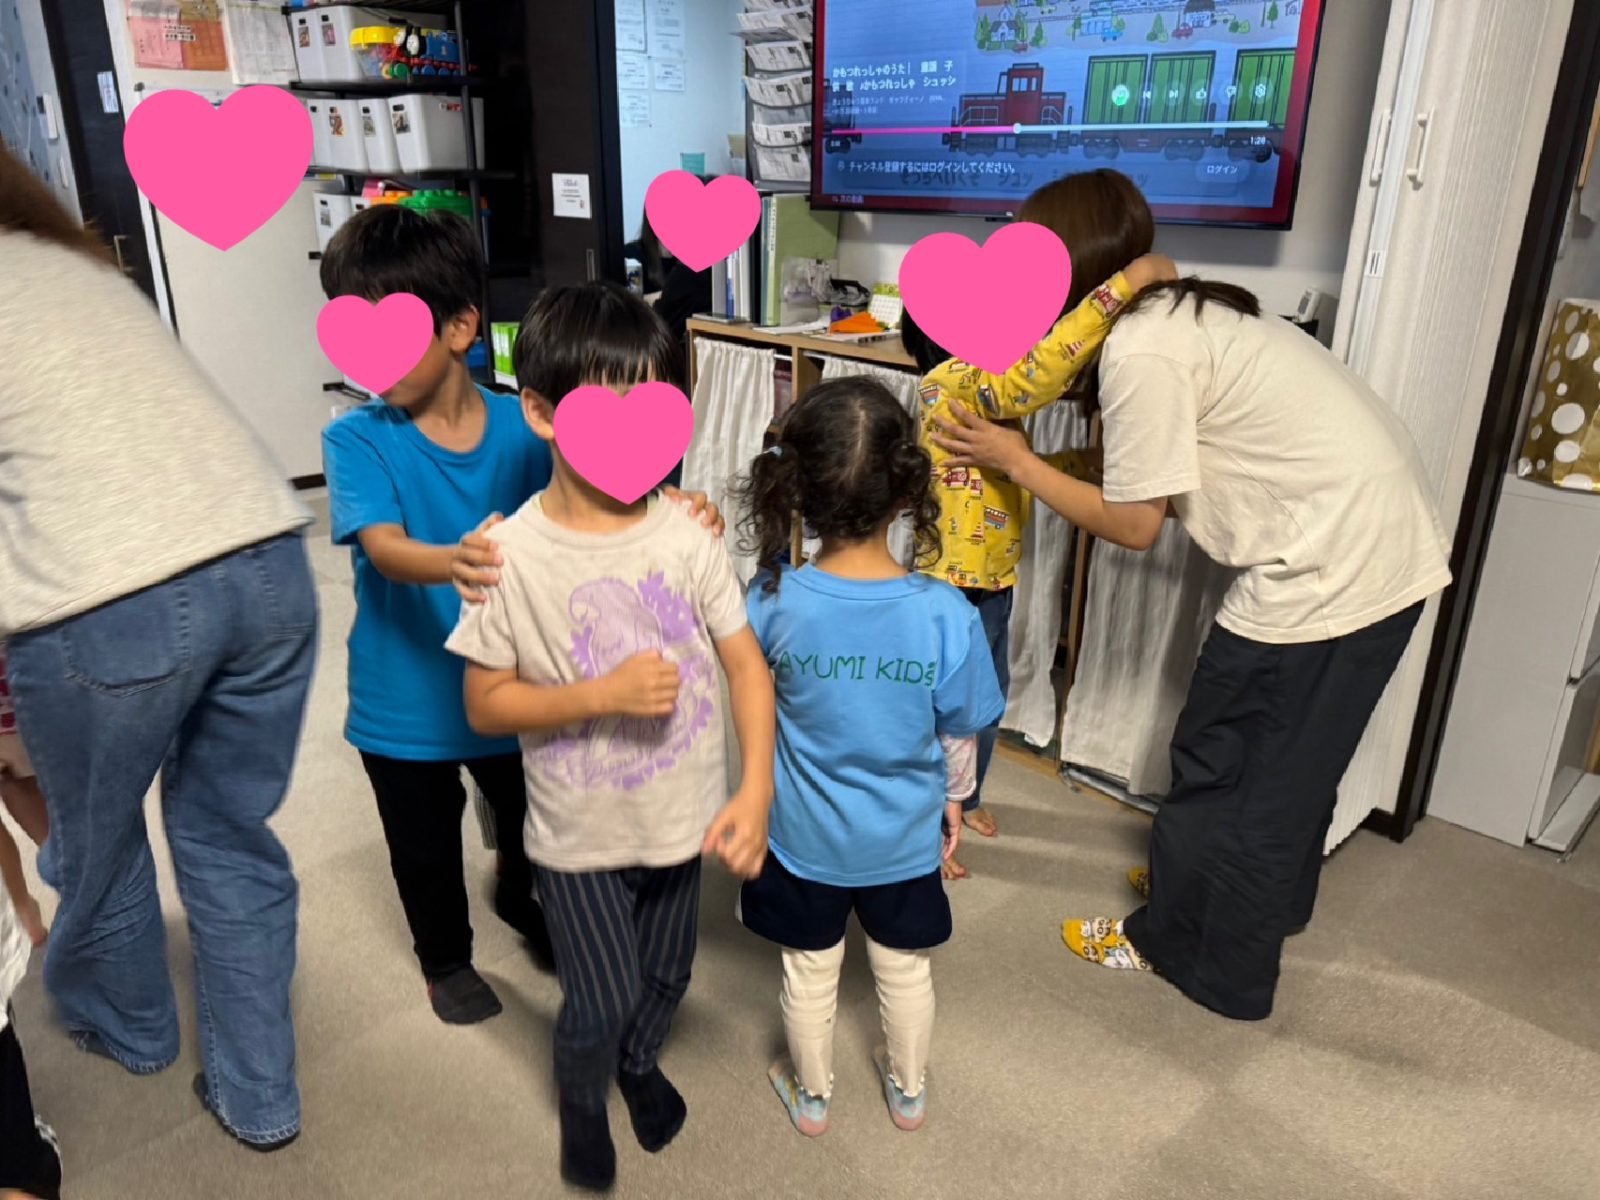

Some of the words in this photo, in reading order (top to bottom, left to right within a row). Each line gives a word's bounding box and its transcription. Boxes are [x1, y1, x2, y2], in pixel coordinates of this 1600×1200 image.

[1207, 165, 1239, 175] ログイン
[779, 651, 866, 680] AYUMI
